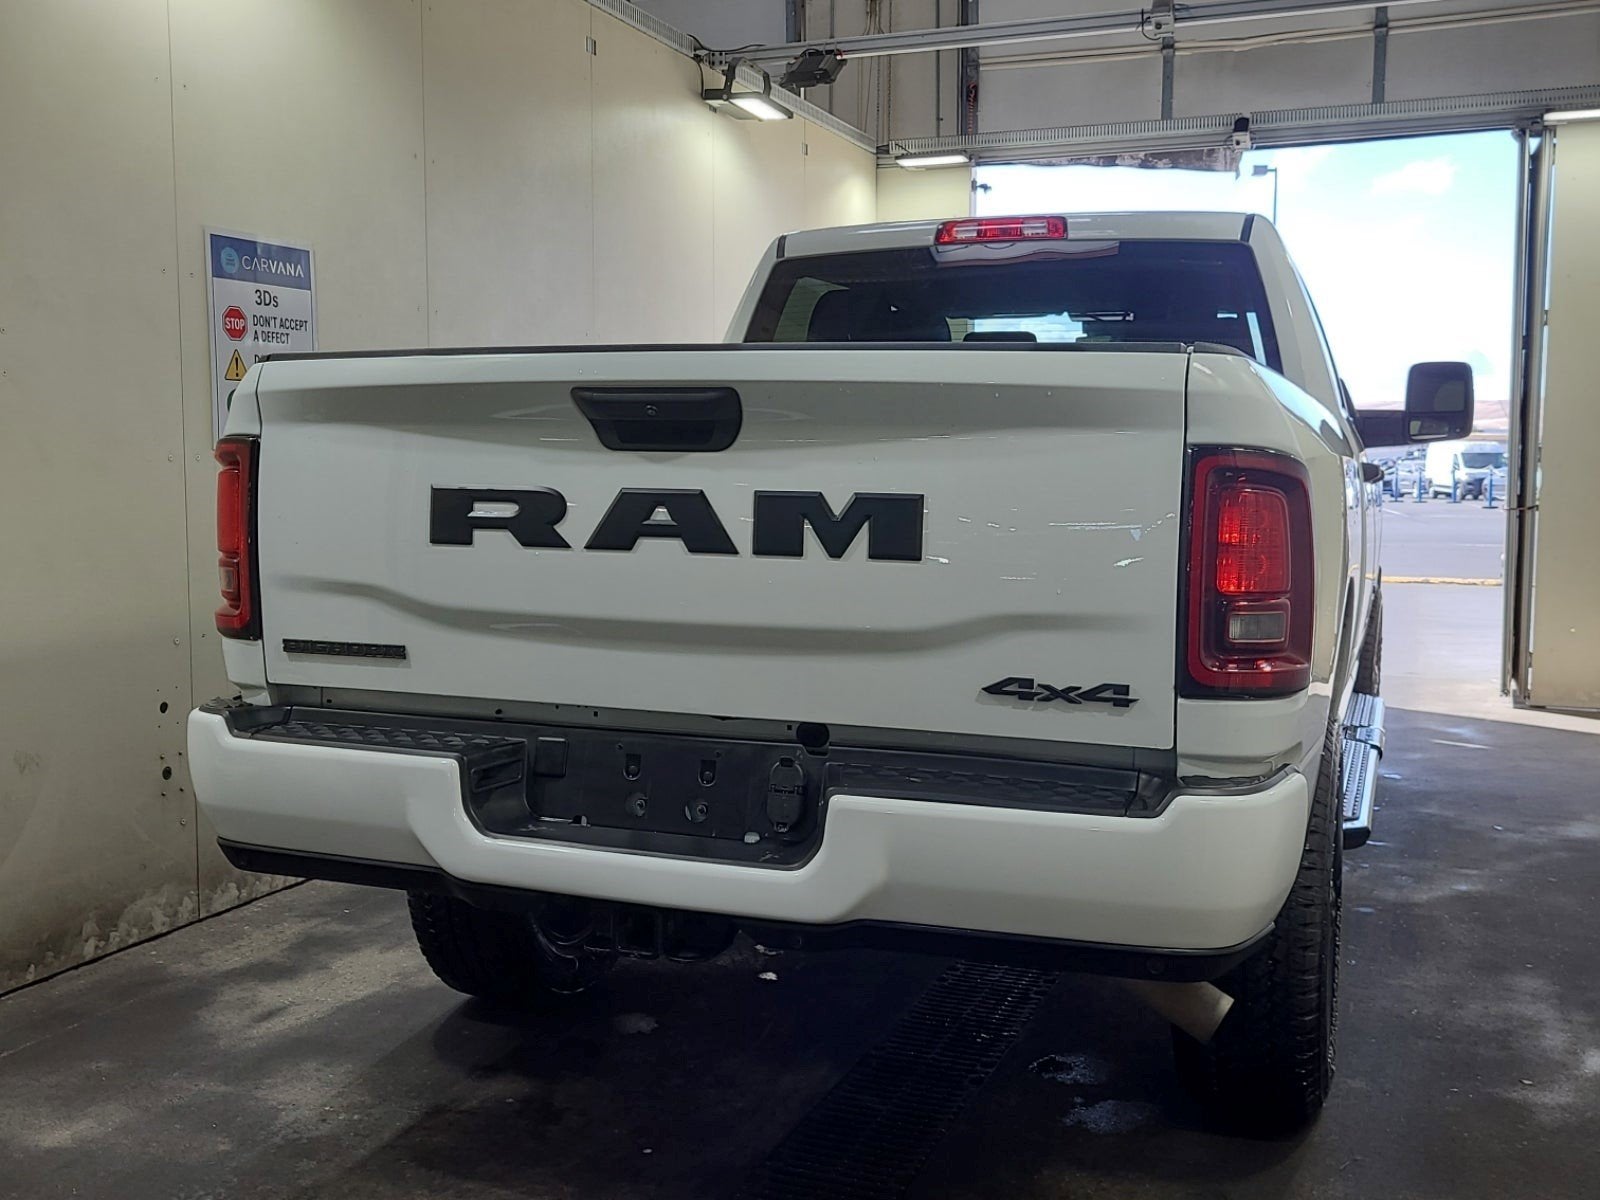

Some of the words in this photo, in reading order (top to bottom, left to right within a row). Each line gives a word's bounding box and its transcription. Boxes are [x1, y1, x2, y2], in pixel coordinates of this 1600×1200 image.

[241, 255, 304, 278] CARVANA
[254, 289, 279, 308] 3Ds
[225, 317, 245, 331] STOP
[252, 314, 278, 329] DON'T
[279, 318, 309, 332] ACCEPT
[253, 329, 260, 342] A
[261, 331, 290, 345] DEFECT
[430, 484, 925, 562] RAM
